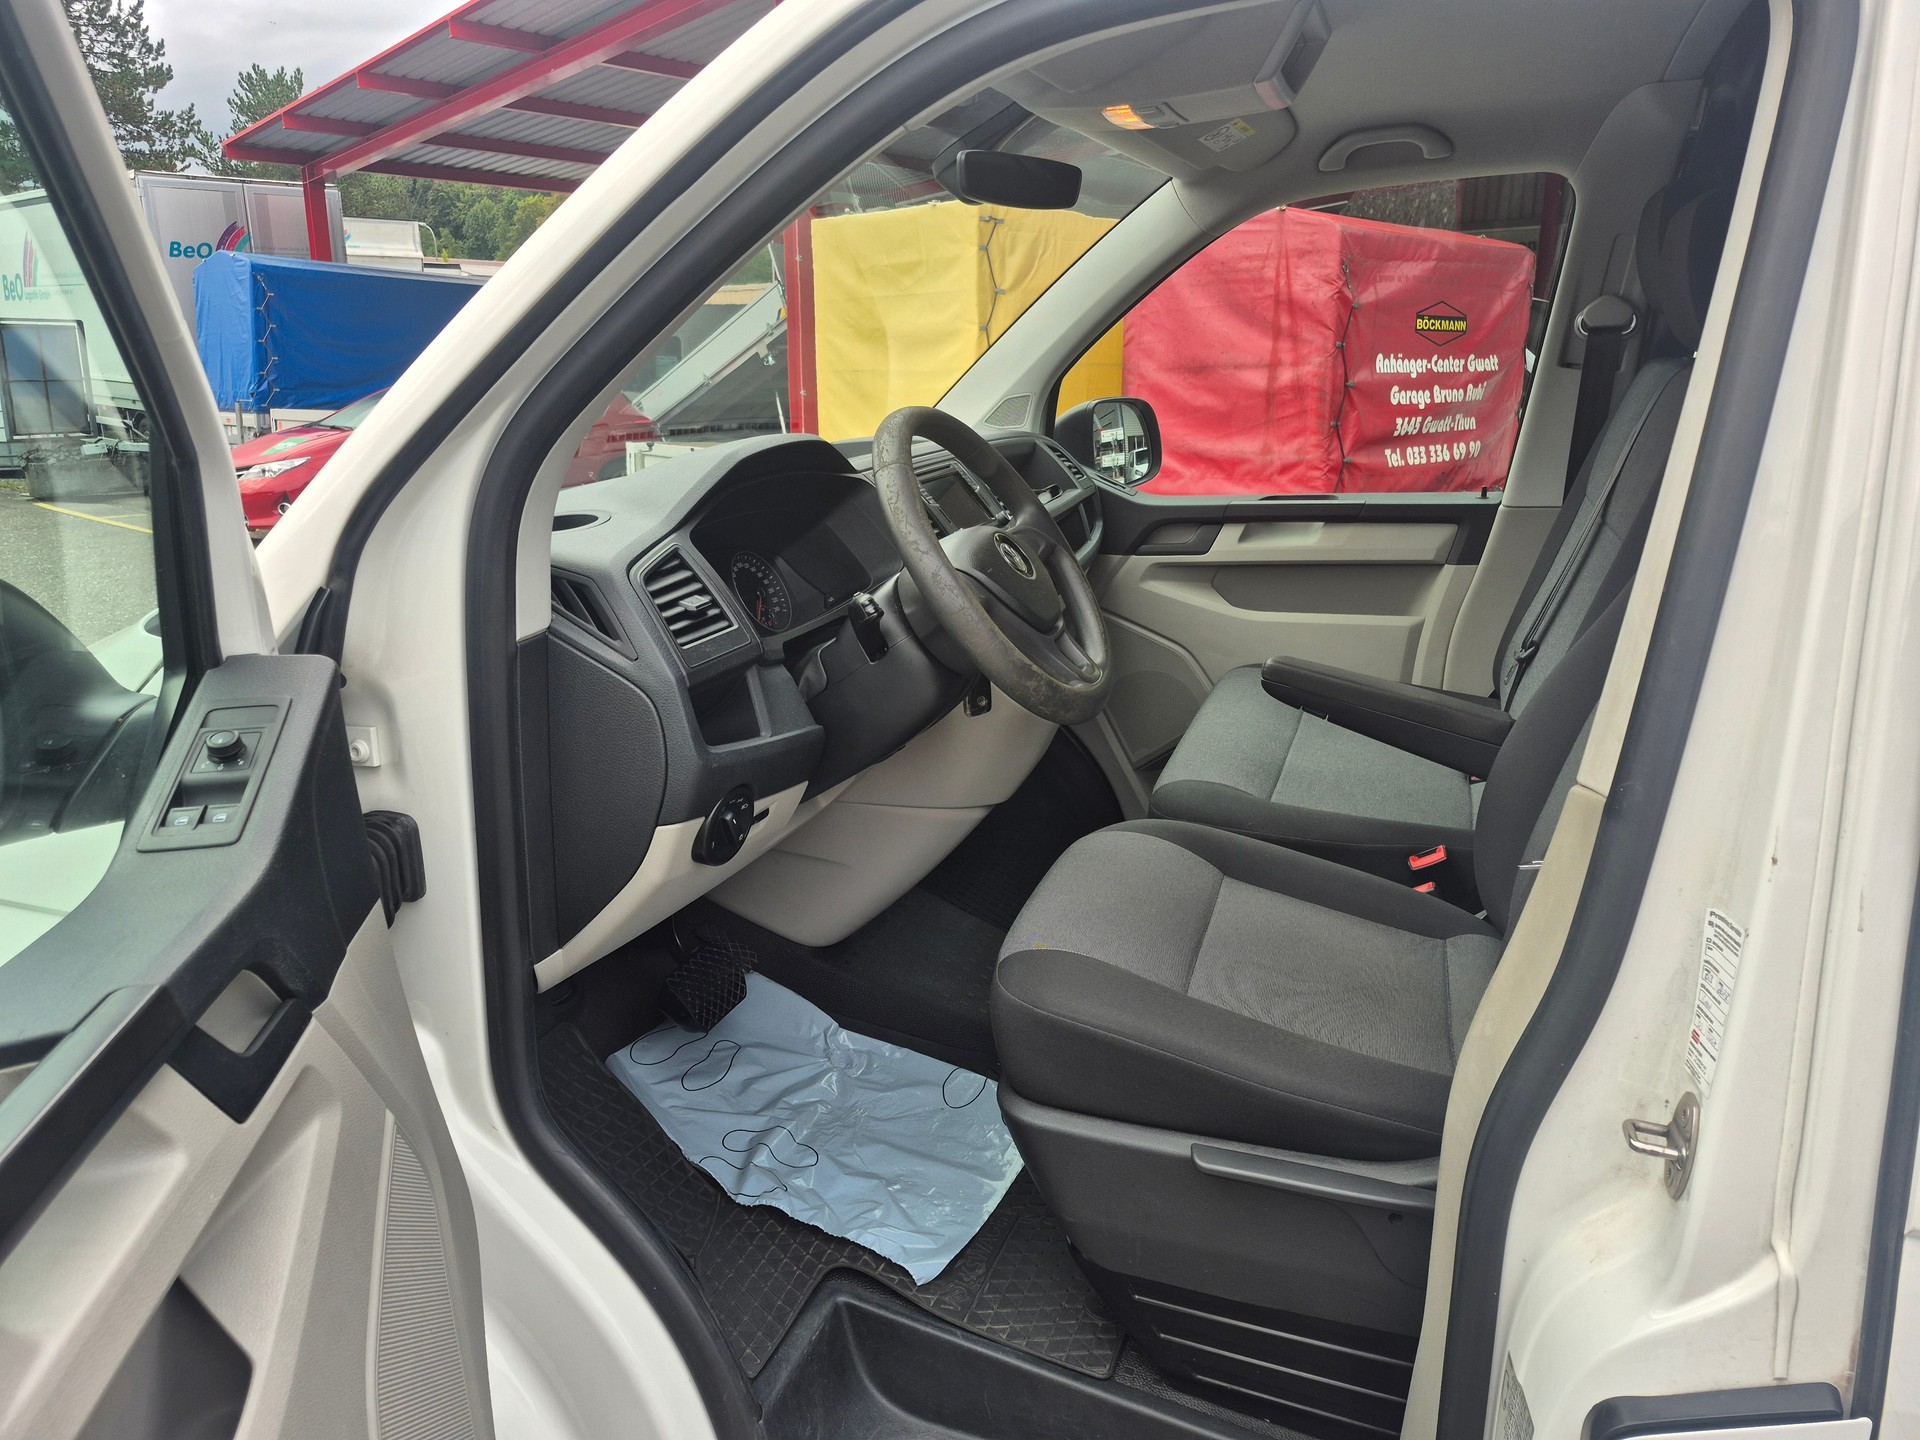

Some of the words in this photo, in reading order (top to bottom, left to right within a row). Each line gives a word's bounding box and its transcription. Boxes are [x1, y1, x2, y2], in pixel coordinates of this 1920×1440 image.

[168, 241, 213, 259] BeO
[2, 273, 24, 301] BeO
[1416, 316, 1467, 332] BÖCKMANN
[1375, 353, 1465, 378] Anhänger-Center
[1467, 353, 1499, 373] Gwatt
[1390, 385, 1431, 409] Garage
[1433, 384, 1464, 404] Bruno
[1393, 416, 1422, 437] 3645
[1422, 413, 1476, 434] Gwatt-Thun
[1384, 447, 1405, 468] Tel.
[1406, 445, 1427, 466] 033
[1429, 443, 1450, 463] 336
[1453, 441, 1467, 461] 69
[1468, 440, 1481, 459] 90
